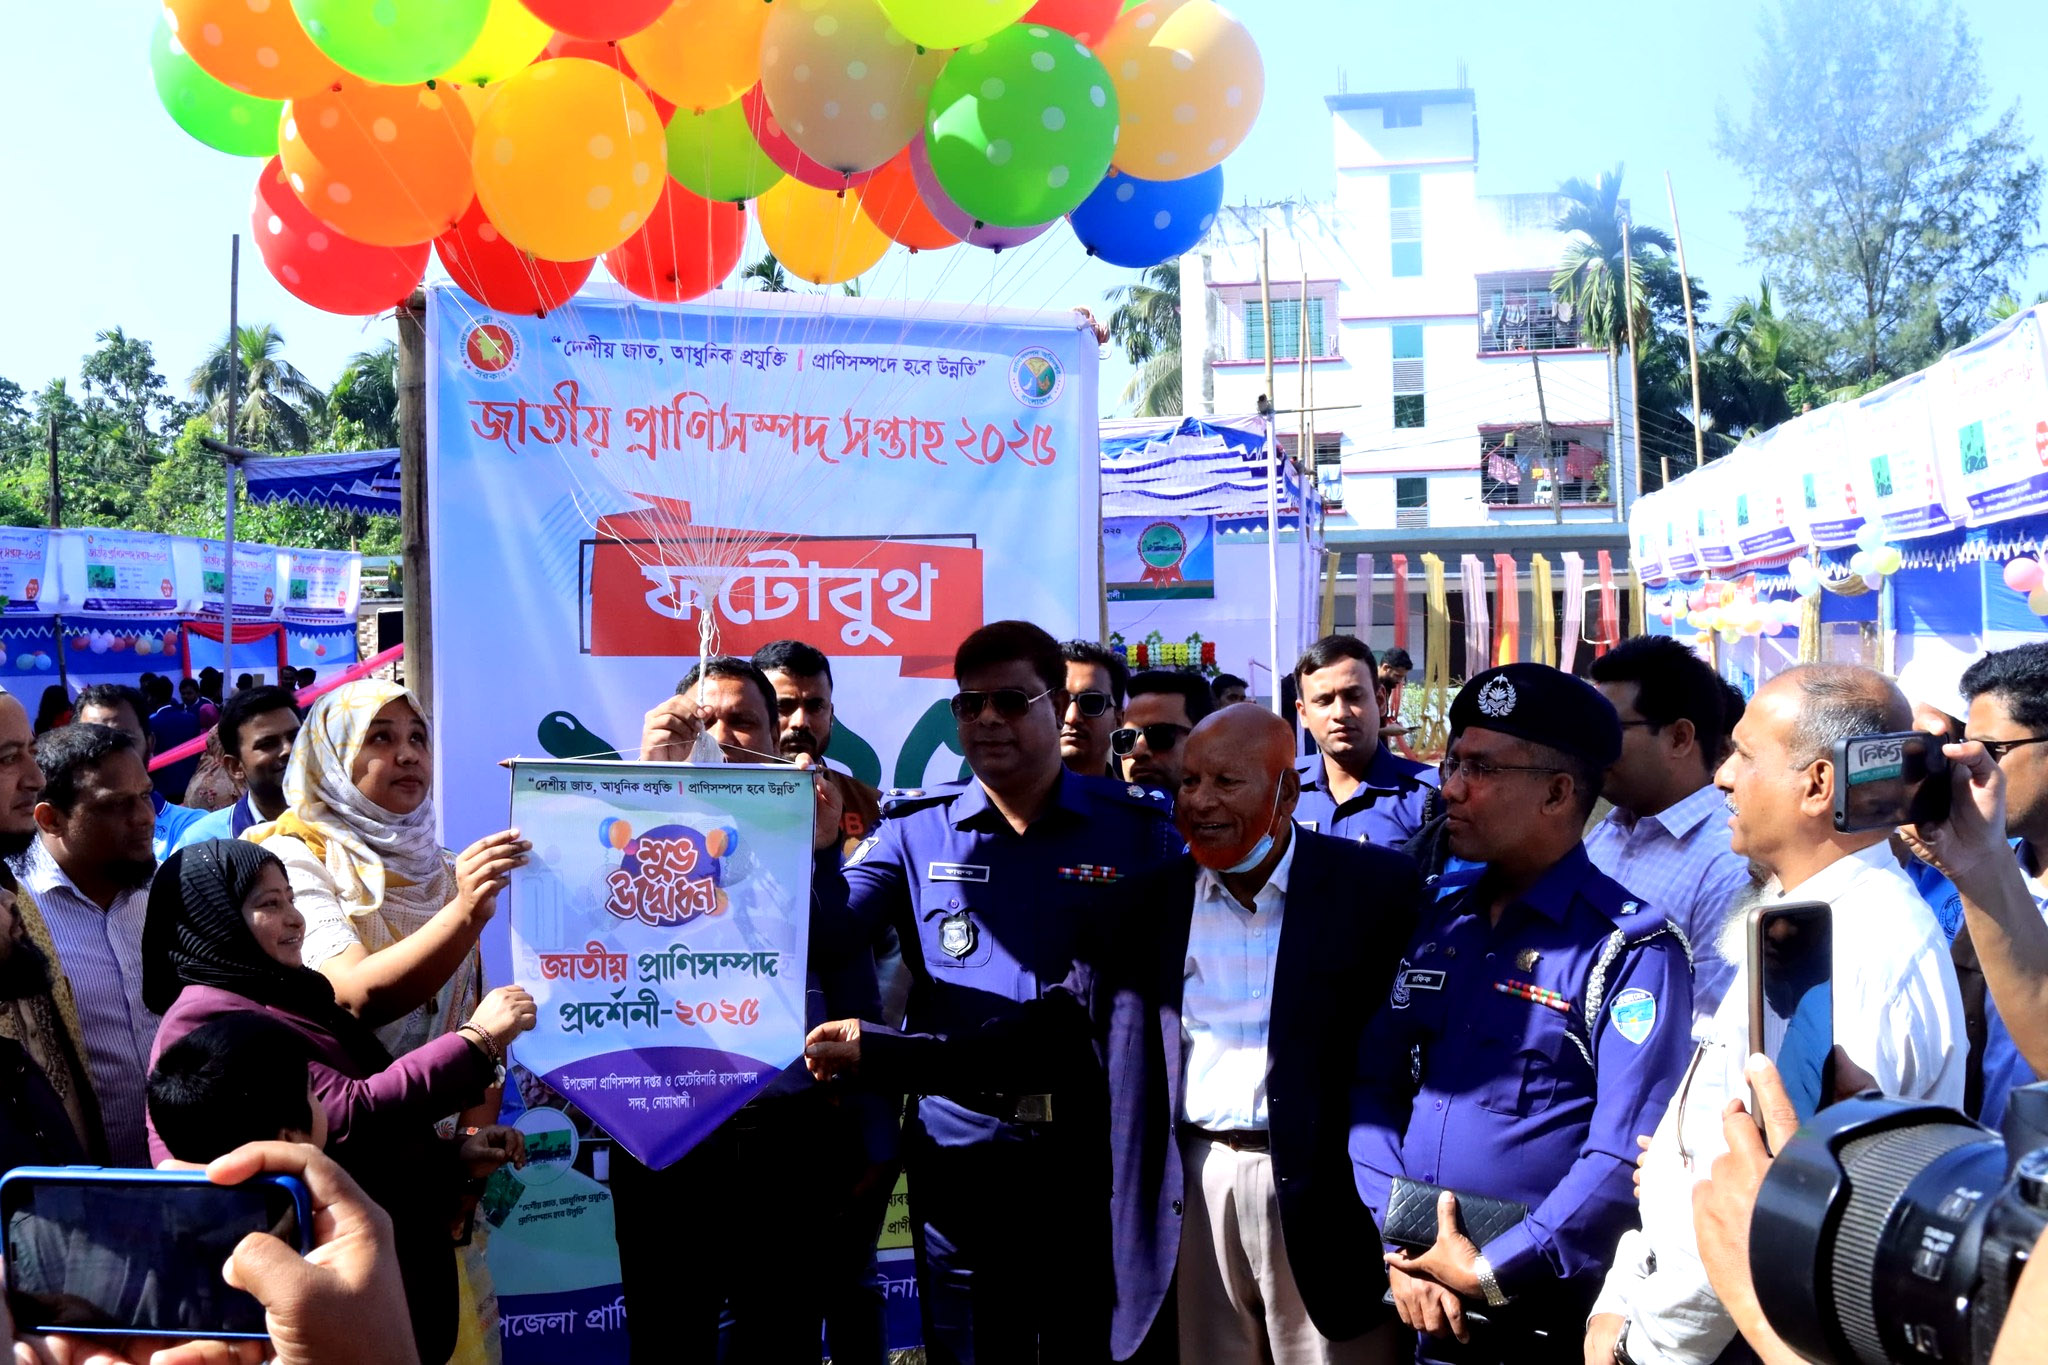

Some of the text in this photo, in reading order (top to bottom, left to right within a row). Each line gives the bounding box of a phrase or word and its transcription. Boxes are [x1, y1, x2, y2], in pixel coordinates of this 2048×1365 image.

[622, 343, 663, 365] জাত,
[671, 343, 735, 368] আধুনিক
[740, 345, 787, 371] প্রযুক্তি
[812, 350, 897, 375] প্রাণিসম্পদে
[903, 358, 932, 377] হবে
[468, 379, 1057, 467] জাতীয় প্রাণিসম্পদ সপ্তাহ ২০২৫
[640, 550, 939, 648] ফটোবুথ
[570, 780, 597, 795] জাত,
[600, 780, 640, 795] আধুনিক
[643, 779, 673, 796] প্রযুক্তি
[687, 780, 743, 795] প্রাণিসম্পদে
[747, 782, 765, 795] হবে
[636, 838, 698, 881] শুভ
[605, 870, 718, 927] উদ্বোধন
[540, 940, 780, 985] জাতীয় প্রাণিসম্পদ
[562, 1069, 758, 1091] উপজেলা প্রাণিসম্পদ দপ্তর ও ভেটেরিনারি হাসপাতাল
[628, 1096, 650, 1113] সদর,
[498, 1308, 579, 1339] পজেলা
